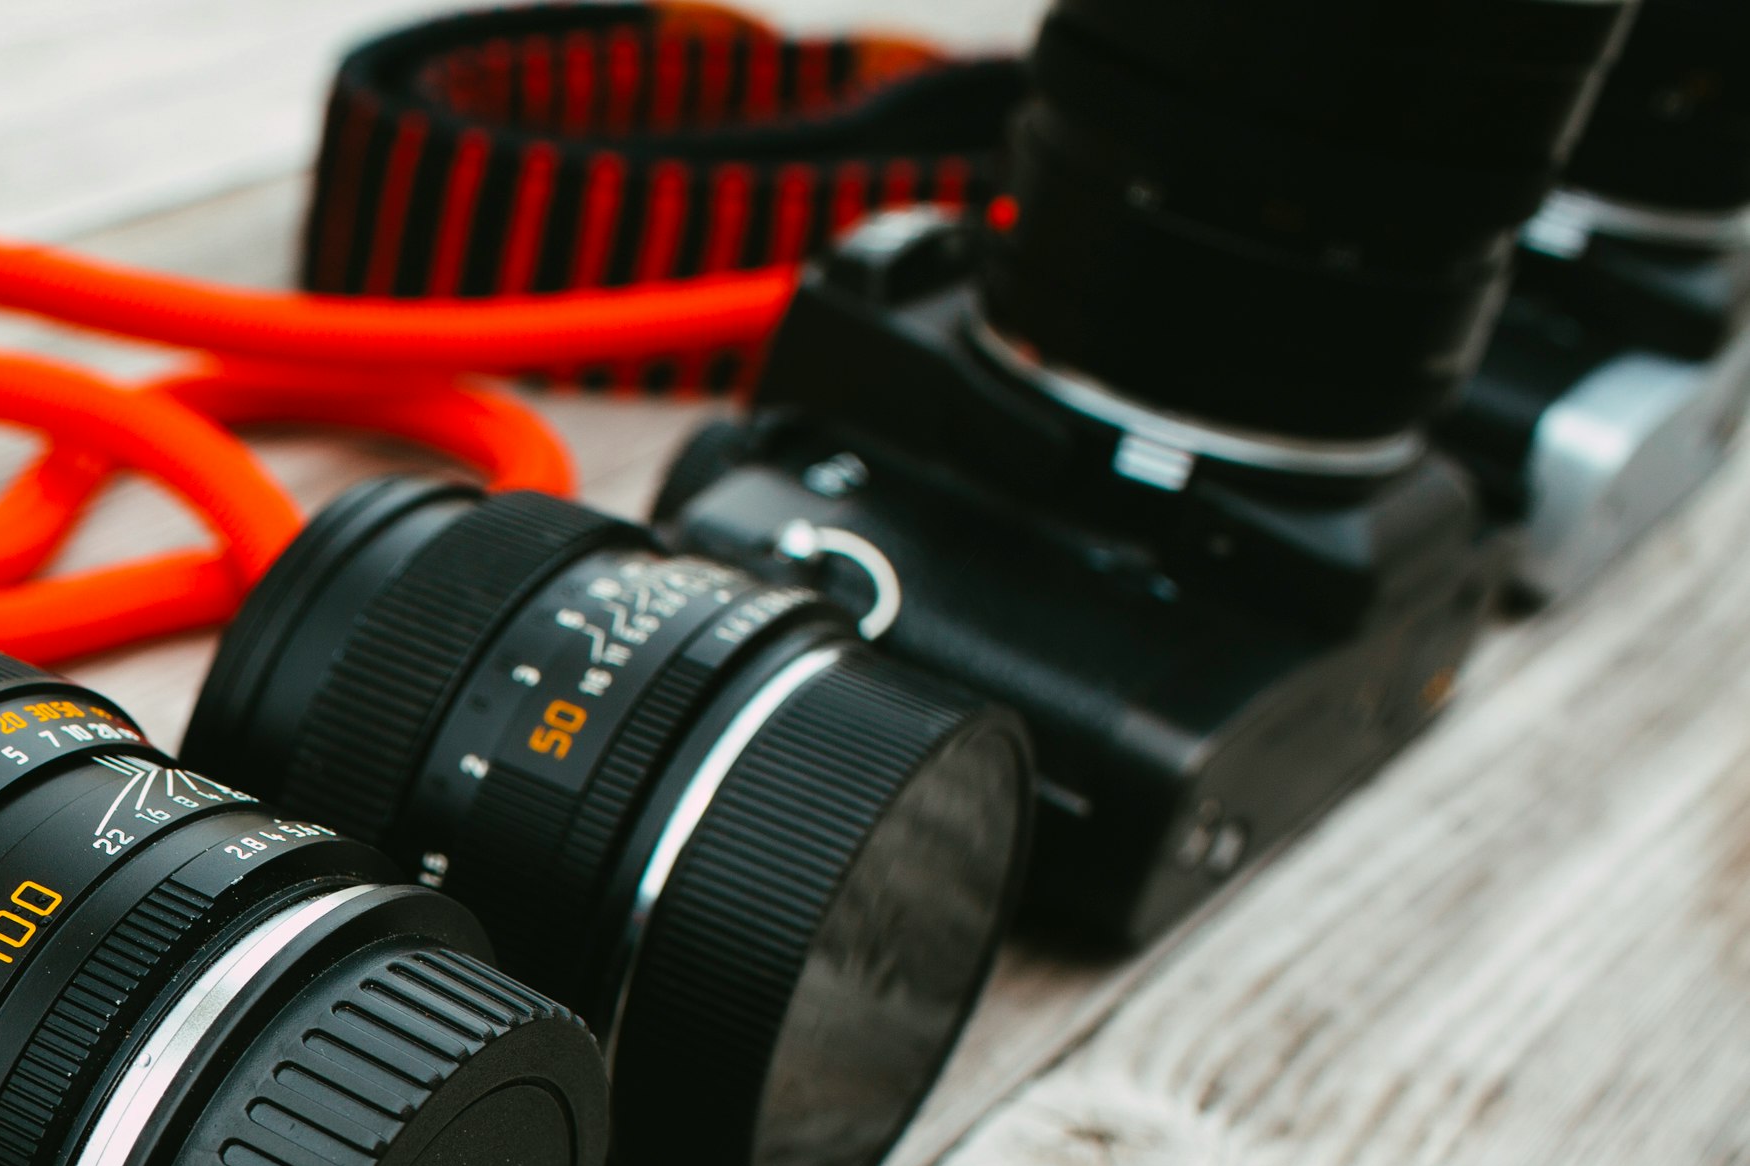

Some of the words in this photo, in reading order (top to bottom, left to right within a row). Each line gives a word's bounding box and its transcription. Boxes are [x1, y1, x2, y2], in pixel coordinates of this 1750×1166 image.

[23, 702, 62, 723] 30
[528, 700, 588, 760] 50
[0, 745, 29, 765] 5
[38, 730, 61, 748] 7
[60, 724, 94, 742] 10
[87, 723, 122, 740] 20
[459, 754, 489, 779] 2
[92, 828, 135, 855] 22
[135, 808, 172, 824] 16
[173, 795, 200, 808] 8
[224, 837, 268, 860] 2.8
[258, 831, 287, 842] 4
[278, 823, 320, 839] 5.6
